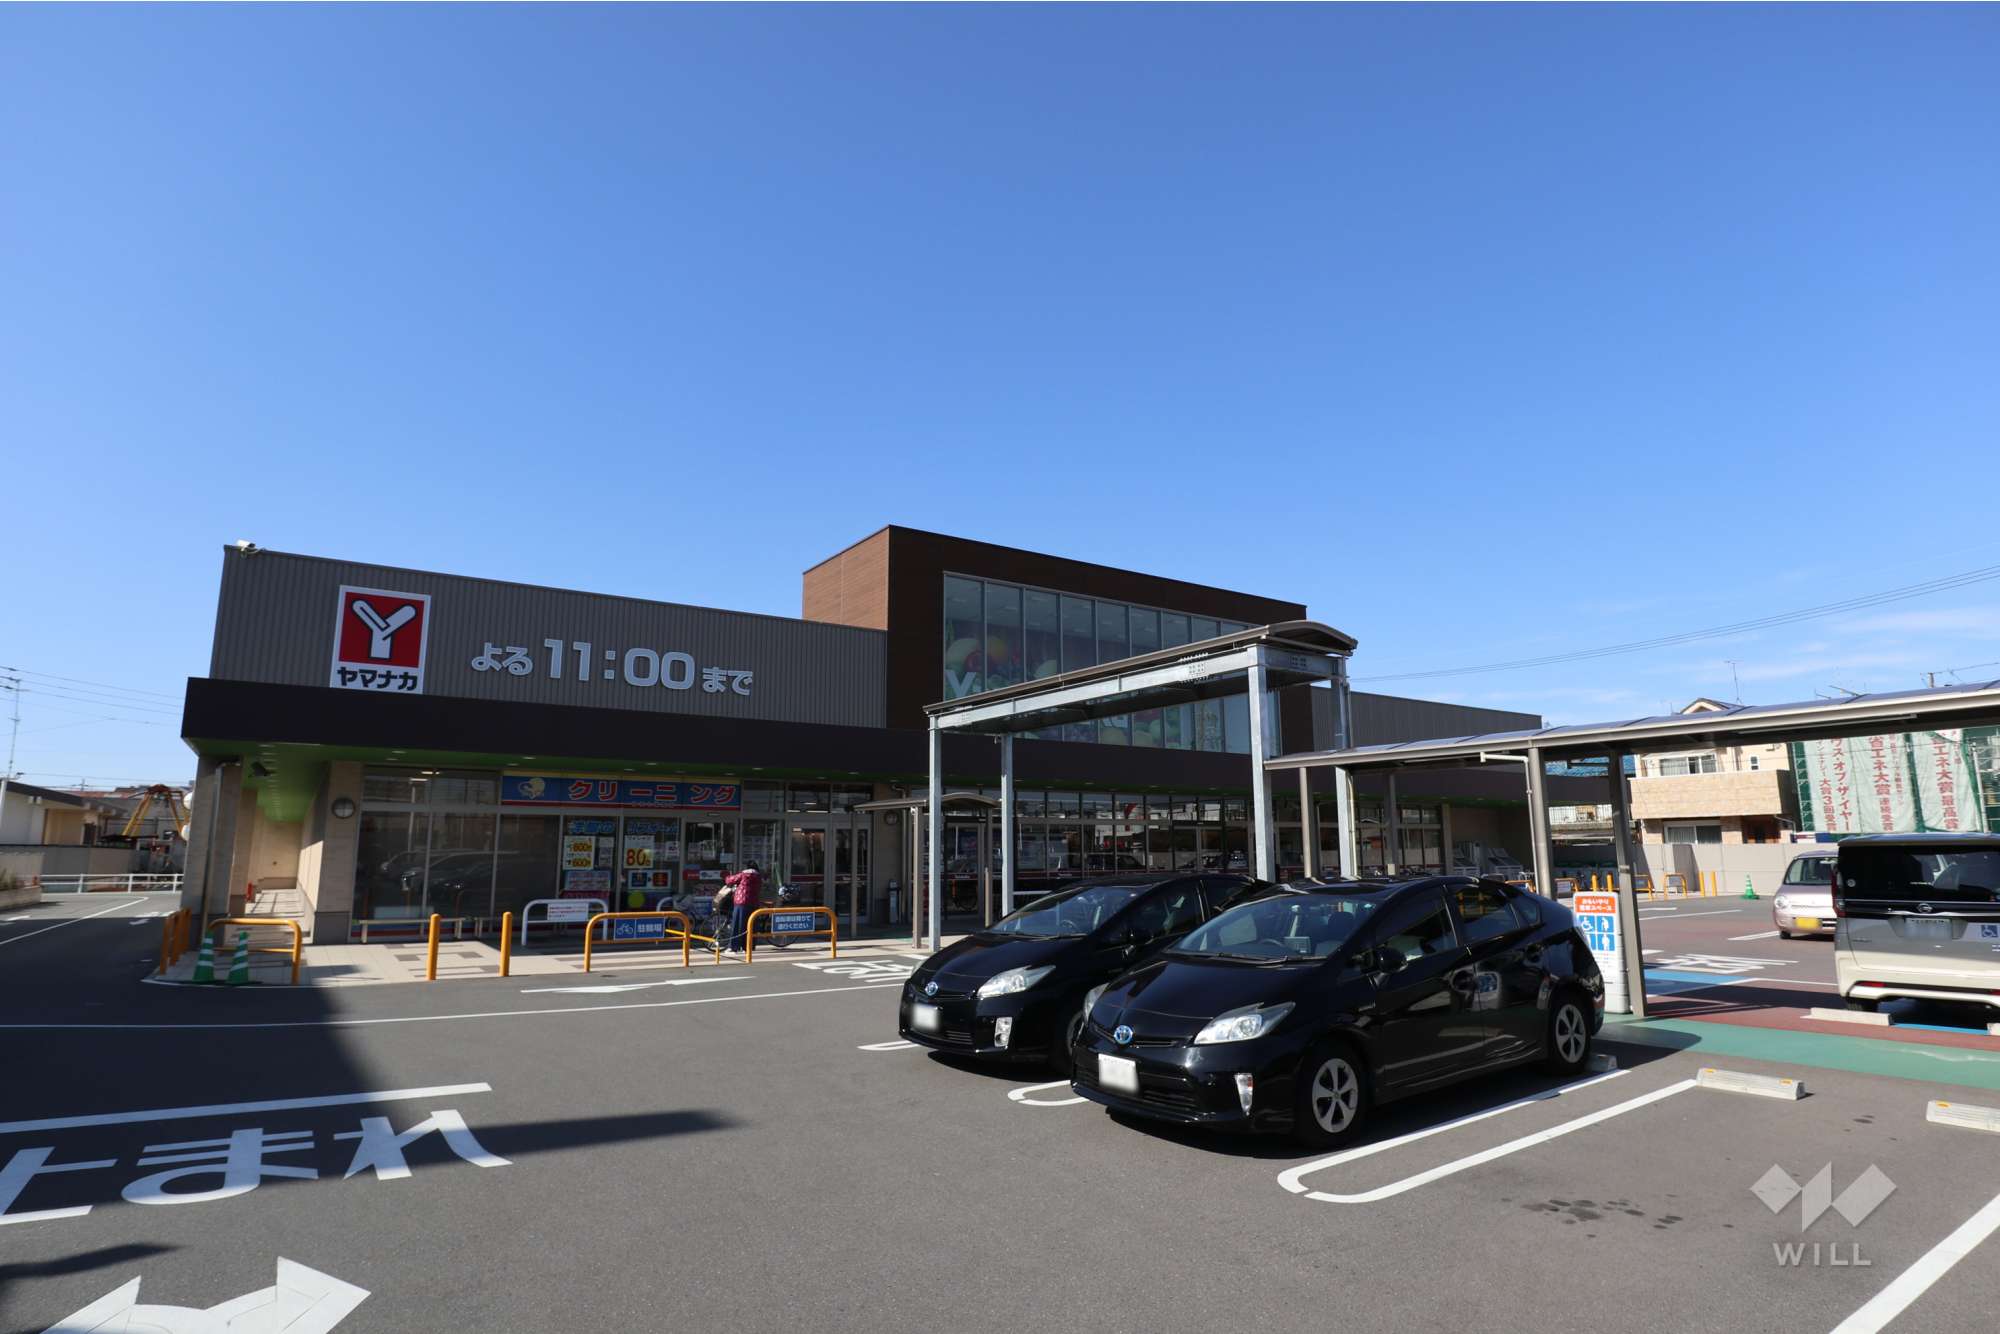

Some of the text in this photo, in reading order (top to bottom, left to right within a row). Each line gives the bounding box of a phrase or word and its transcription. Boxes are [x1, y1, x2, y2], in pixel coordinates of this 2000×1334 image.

[336, 666, 419, 691] ヤマナカ
[567, 779, 736, 804] クリーニング
